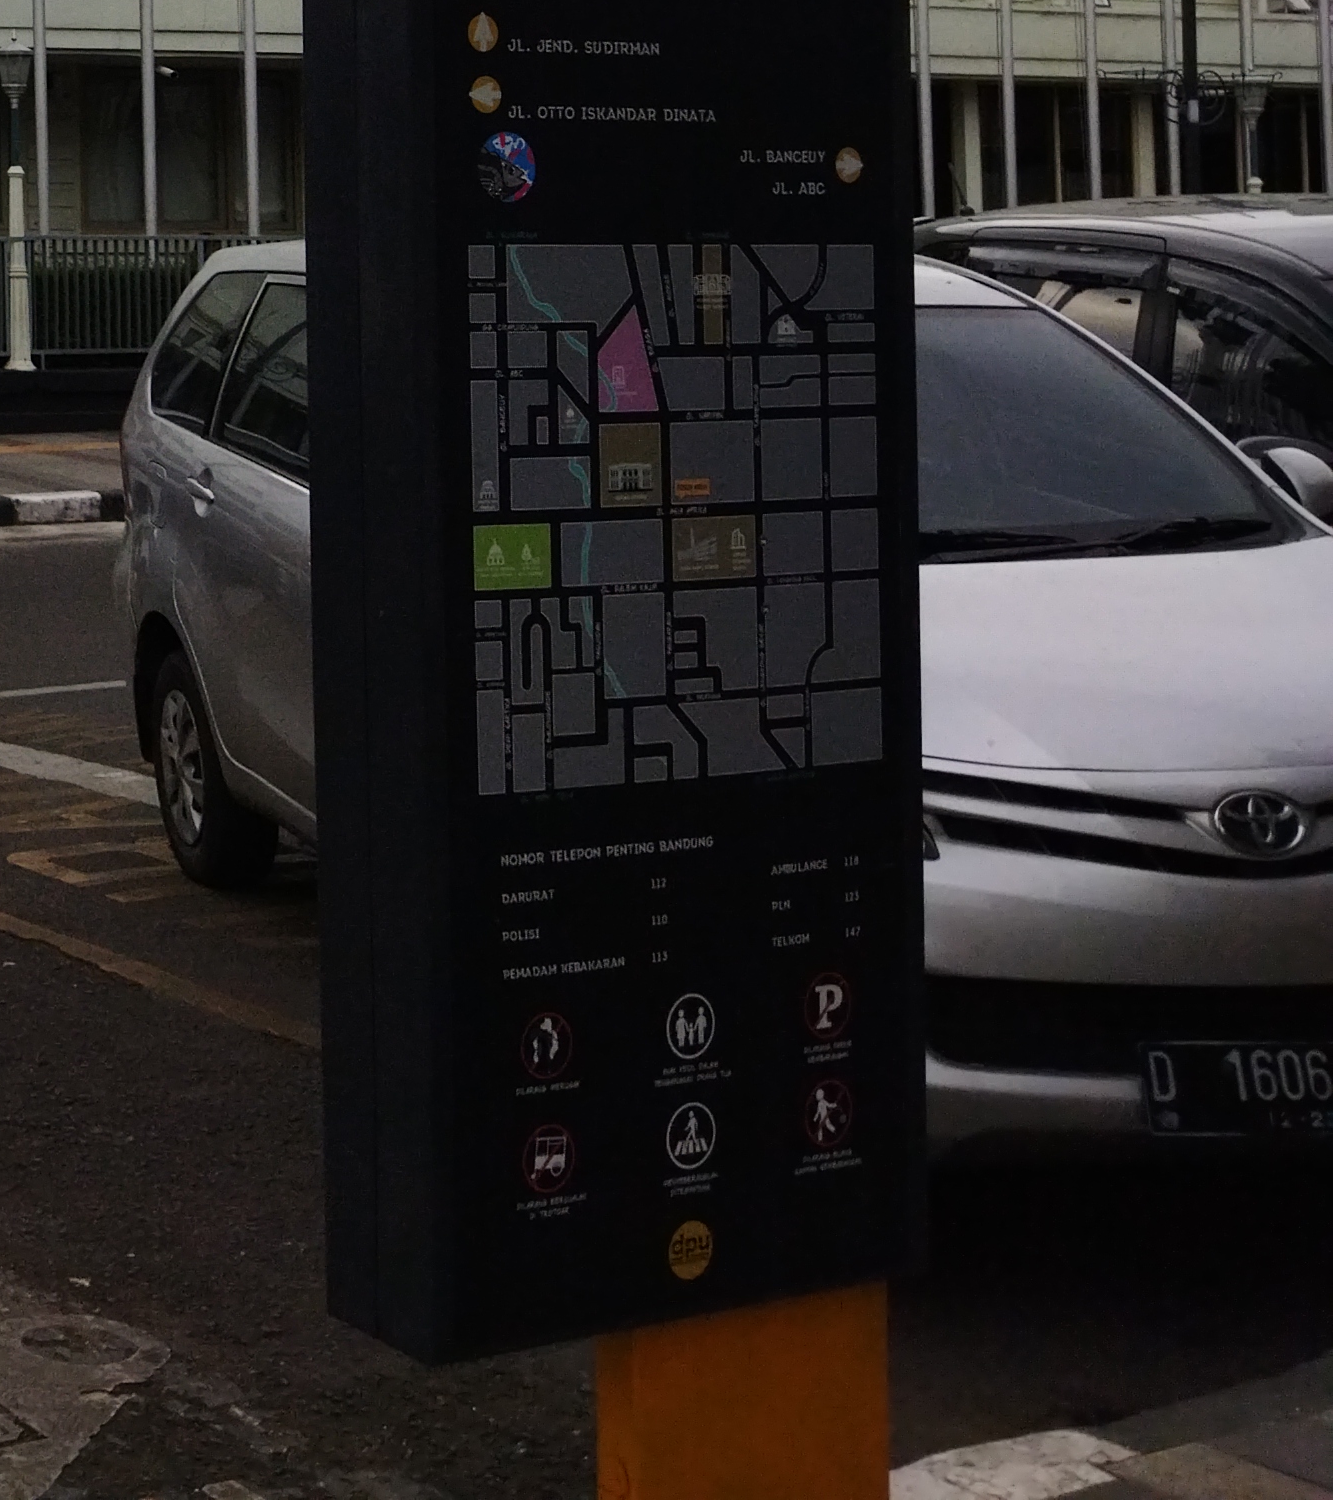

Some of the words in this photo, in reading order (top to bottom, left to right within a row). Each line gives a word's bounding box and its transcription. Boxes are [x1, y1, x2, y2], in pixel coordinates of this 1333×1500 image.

[507, 38, 531, 53] JL.
[536, 39, 578, 54] JEND.
[583, 40, 661, 56] SUDIRMAN
[507, 105, 532, 120] JL.
[537, 106, 576, 121] OTTO
[581, 106, 657, 122] ISKANDAR
[663, 108, 717, 122] DINATA
[739, 150, 761, 164] JL.
[766, 150, 826, 164] BANCEUY
[772, 182, 794, 197] JL.
[798, 182, 827, 197] ABC
[500, 851, 545, 867] NOMOR
[549, 846, 602, 863] TELEPON
[606, 841, 655, 858] PENTING
[659, 835, 714, 853] BANDUNG
[770, 858, 829, 876] AMBULANCE
[501, 888, 555, 905] DARURAT
[650, 877, 667, 890] 112
[771, 899, 792, 911] PLN
[502, 928, 540, 942] POLISI
[651, 913, 669, 926] 110
[771, 932, 811, 948] TELKOM
[845, 925, 862, 939] 147
[502, 963, 558, 981] PEMADAM
[561, 956, 627, 974] KEBAKARAN
[1147, 1050, 1177, 1103] D
[1223, 1047, 1333, 1103] 1606
[672, 1233, 711, 1259] dpu
